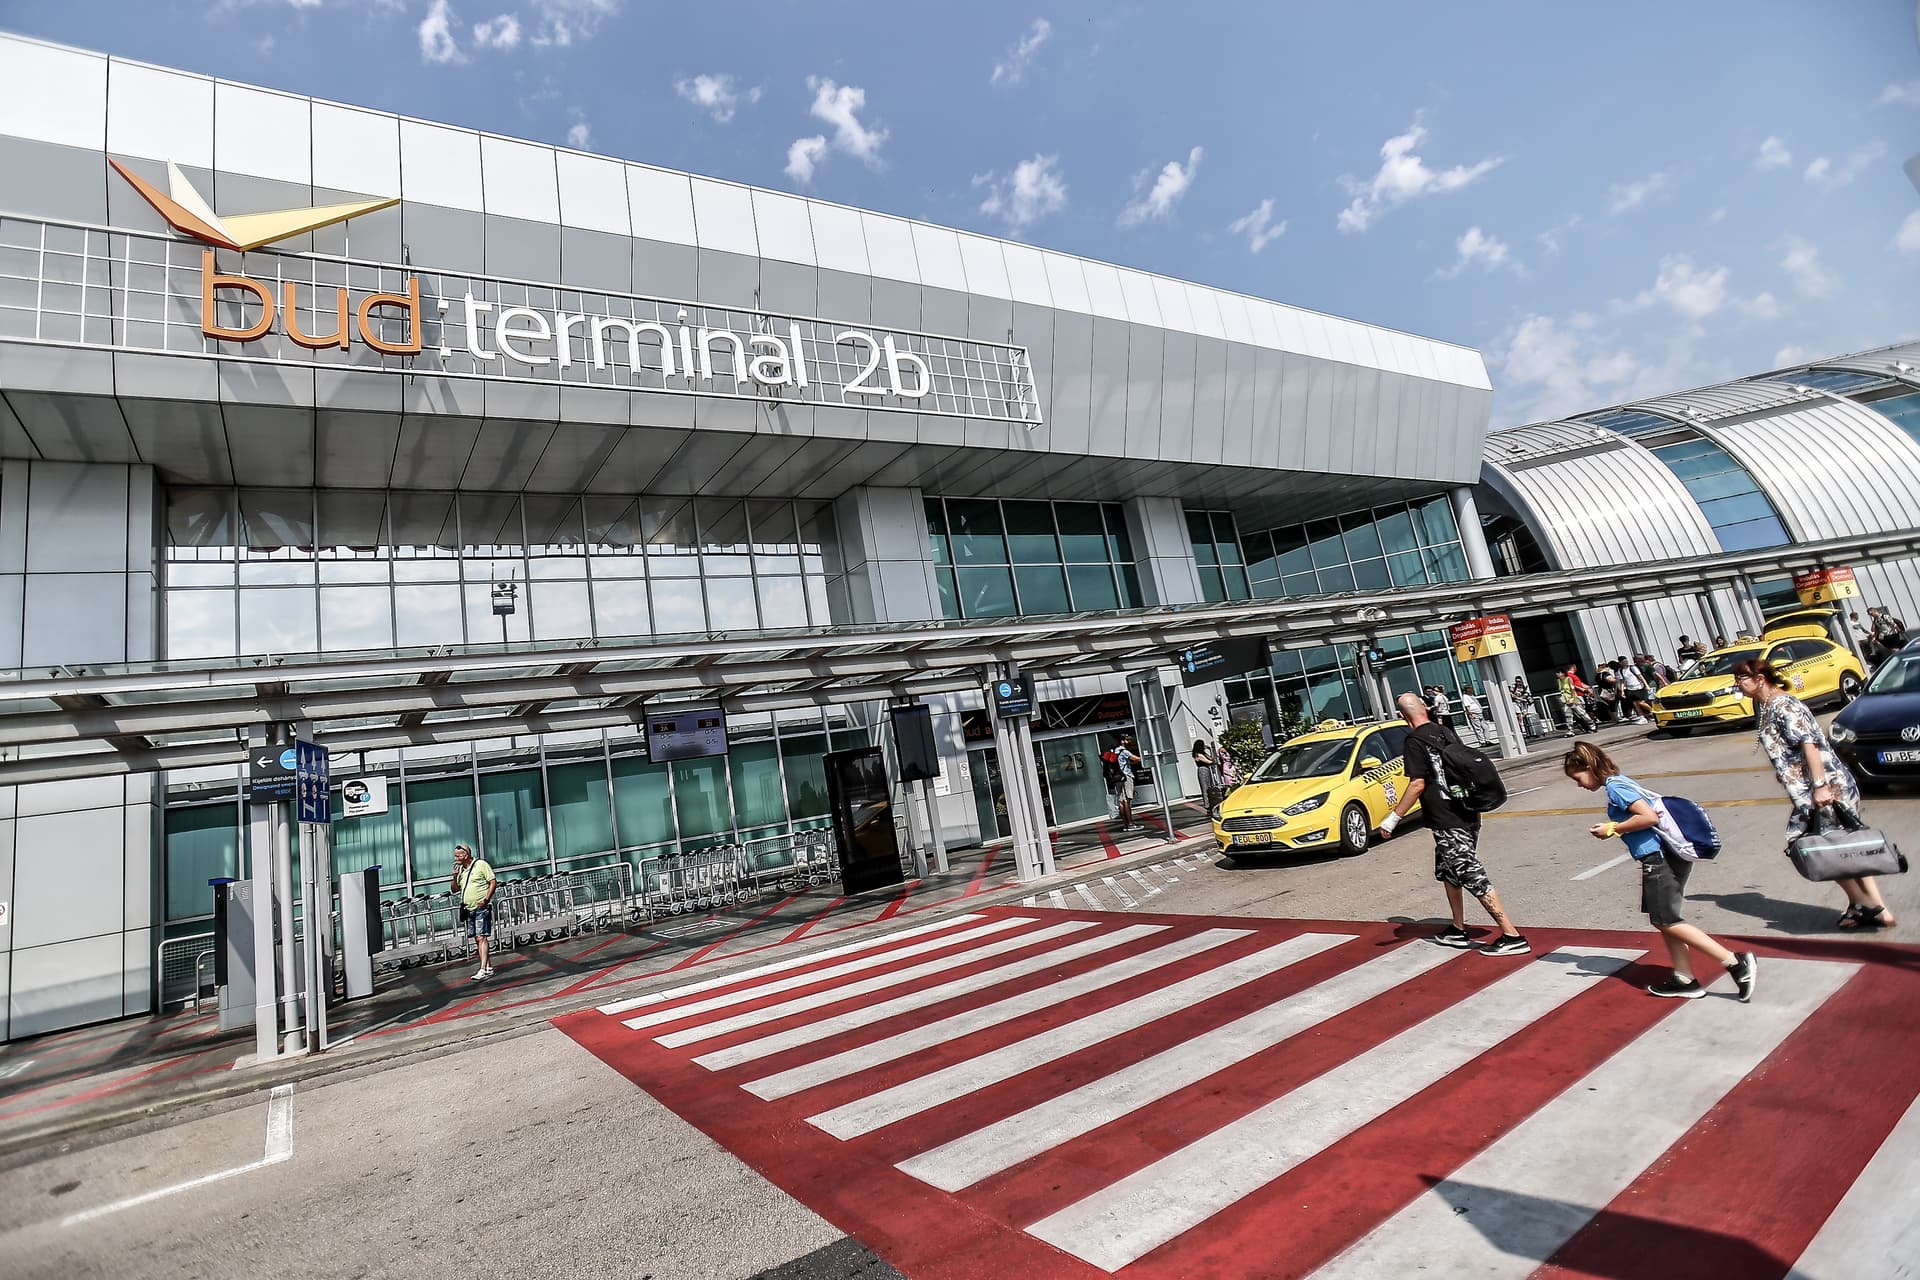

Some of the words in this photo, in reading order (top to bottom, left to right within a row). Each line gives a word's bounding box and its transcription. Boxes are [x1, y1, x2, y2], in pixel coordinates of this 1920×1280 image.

[835, 330, 930, 398] 2b
[1500, 639, 1507, 650] 9
[1468, 645, 1476, 656] 9
